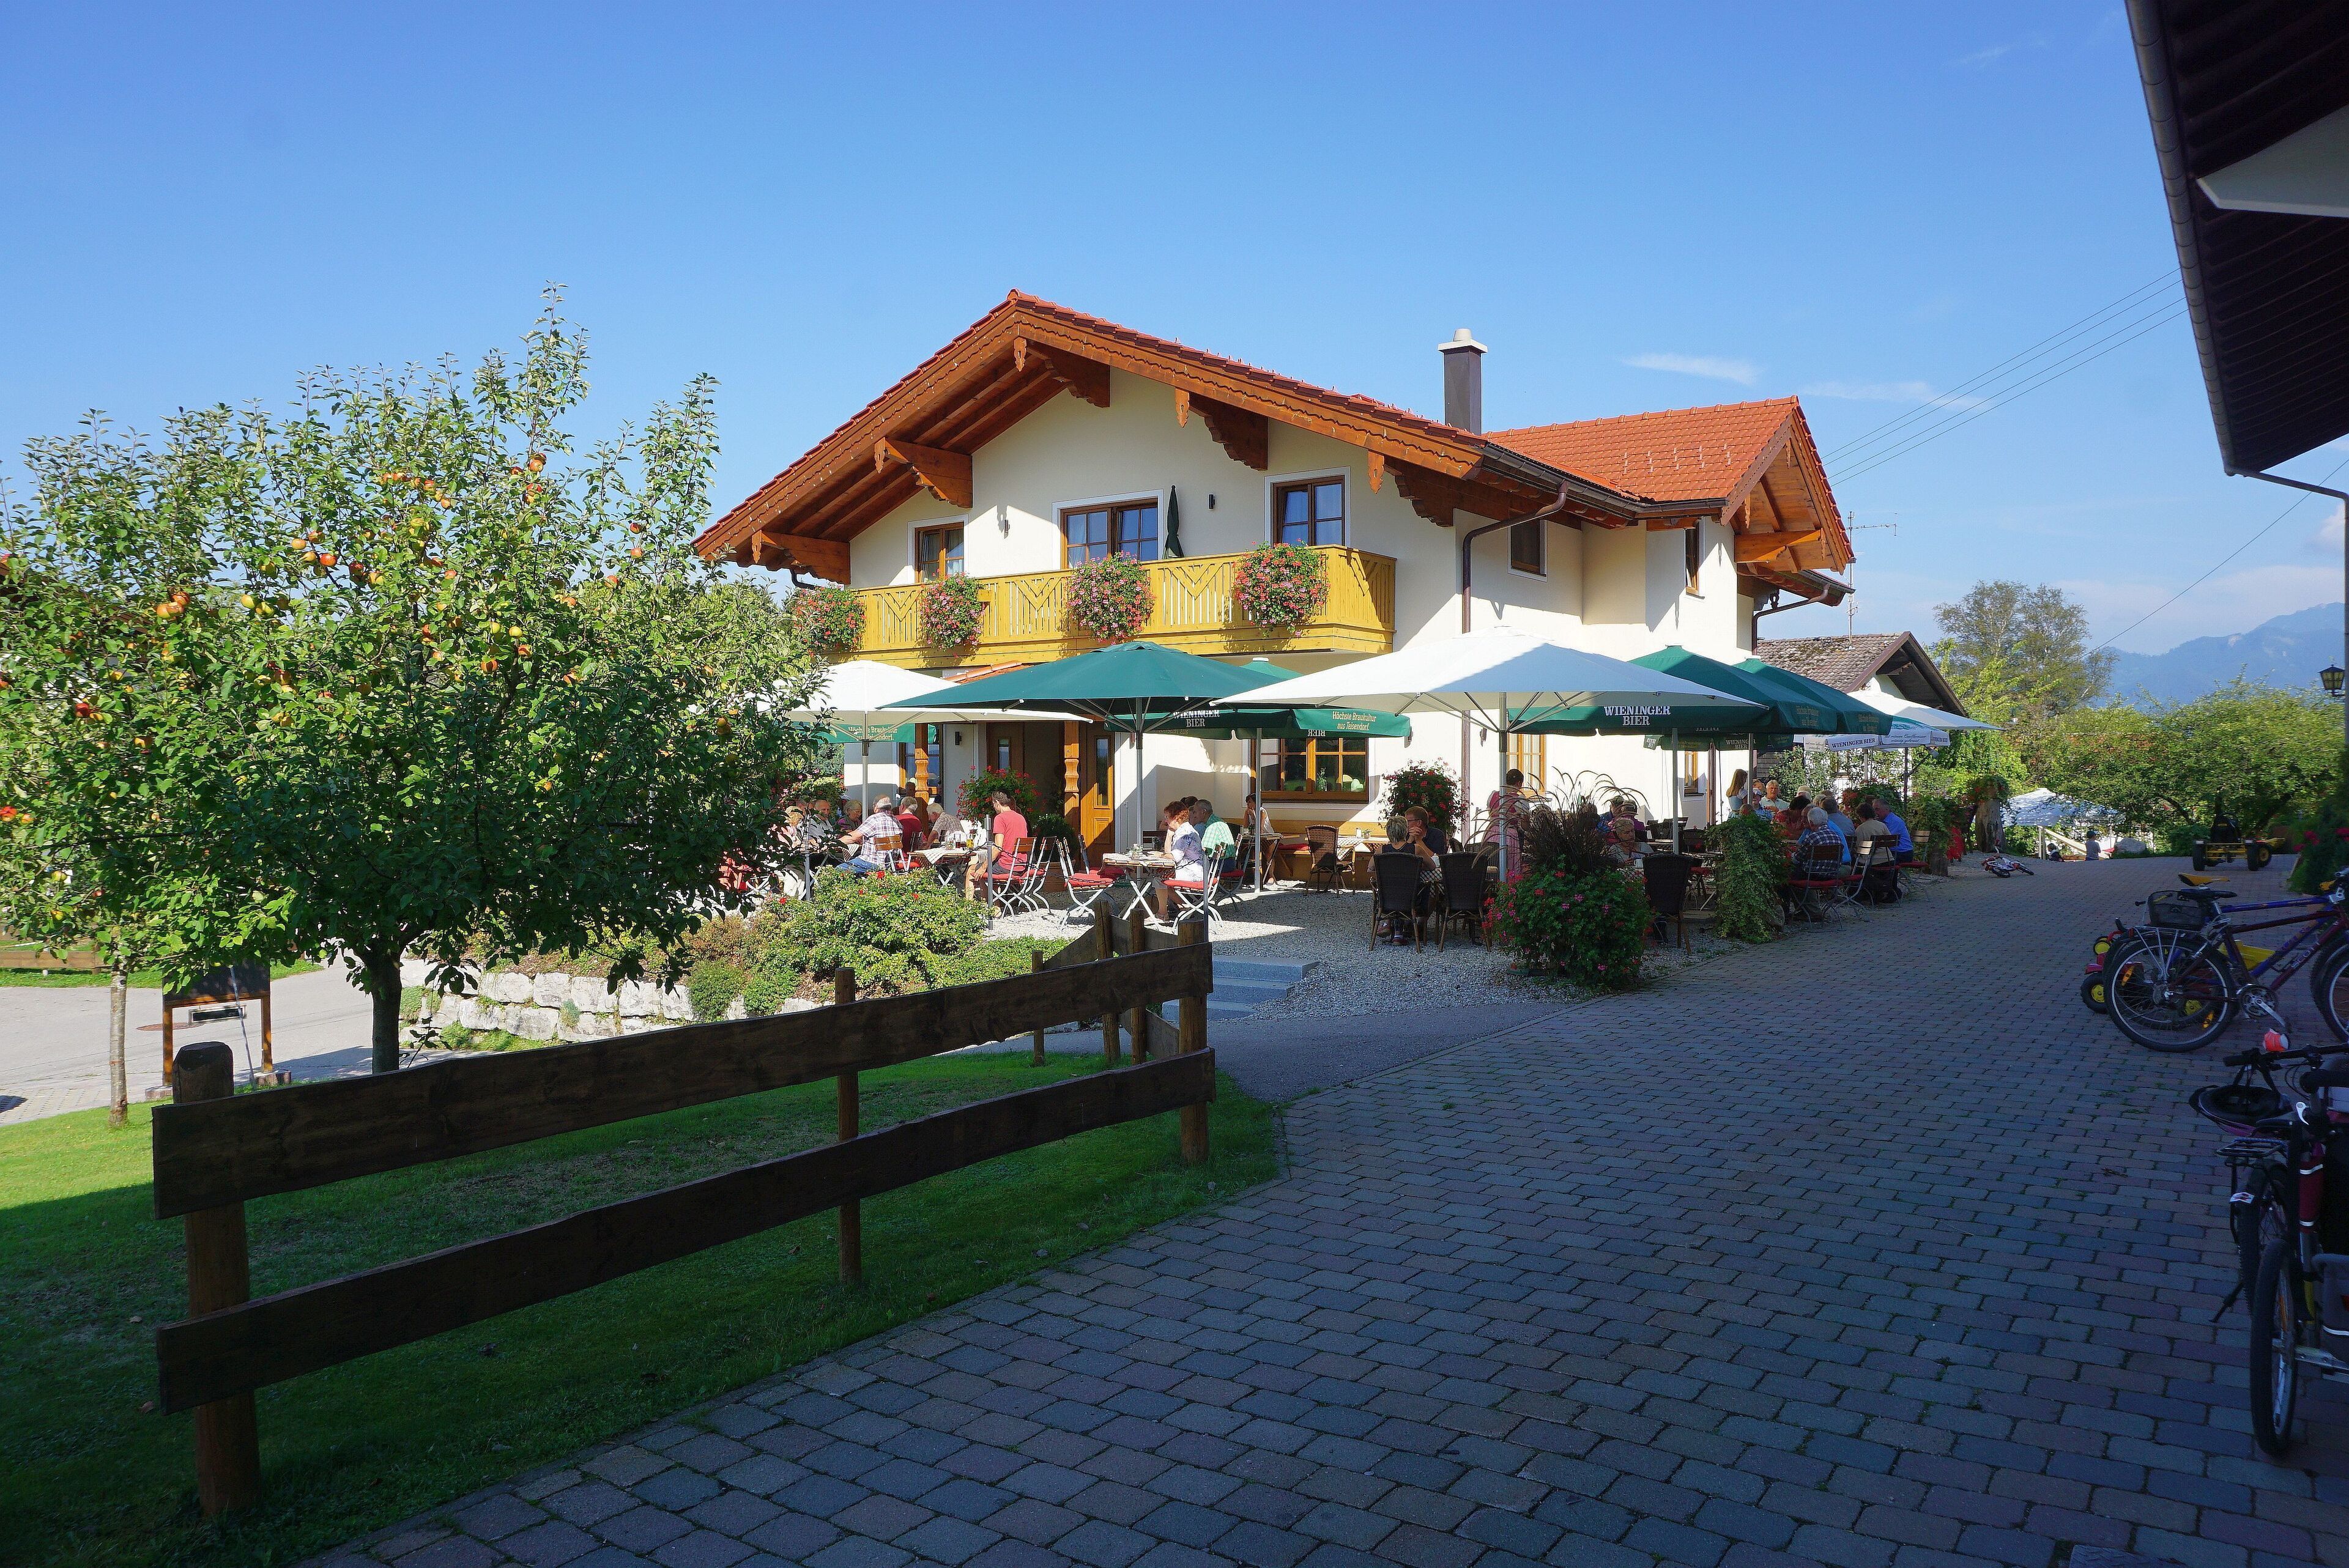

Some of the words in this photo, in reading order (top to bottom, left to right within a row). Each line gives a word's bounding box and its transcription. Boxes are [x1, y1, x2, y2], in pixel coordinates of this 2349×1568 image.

[1603, 705, 1671, 716] WIENINGER
[1332, 711, 1352, 720] Höchste
[1353, 712, 1376, 722] Braukultur
[1622, 716, 1650, 726] BIER
[1186, 719, 1206, 727] BIER
[1346, 722, 1370, 731] Teisendorf.
[1831, 739, 1863, 749] WIENINGER
